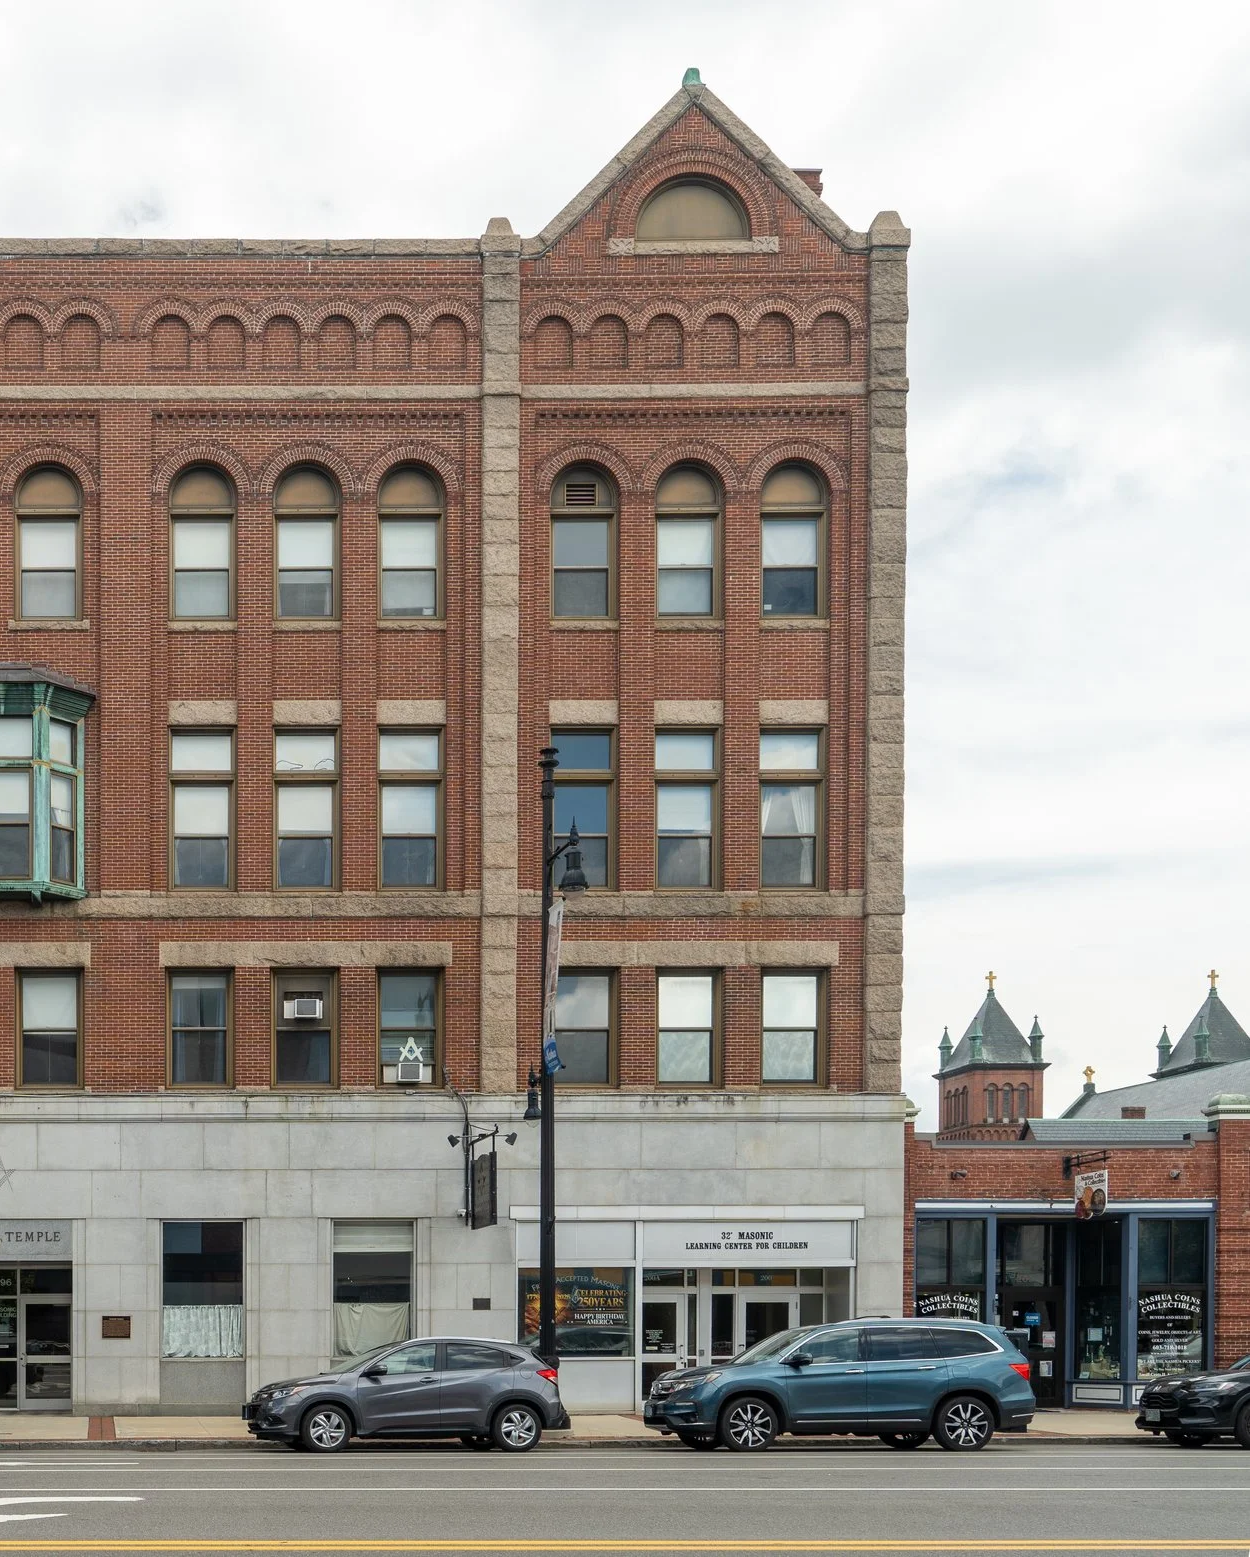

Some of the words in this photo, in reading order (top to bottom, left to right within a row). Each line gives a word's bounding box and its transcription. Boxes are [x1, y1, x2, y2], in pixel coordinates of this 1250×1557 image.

[4, 1231, 61, 1242] TEMPLE
[738, 1231, 774, 1240] MASONIC
[685, 1242, 722, 1250] LEARNING
[724, 1242, 753, 1250] CENTER
[755, 1241, 770, 1250] FOR
[772, 1241, 809, 1250] CHILDREN
[555, 1275, 589, 1283] ACCEPTED
[590, 1276, 620, 1290] MASONS
[918, 1294, 951, 1307] NASHUA
[953, 1294, 979, 1306] COINS
[1138, 1293, 1172, 1307] NASHUA
[1174, 1293, 1201, 1305] COINS
[921, 1302, 979, 1314] COLLECTIBLES
[1141, 1301, 1201, 1313] COLLECTIBLES
